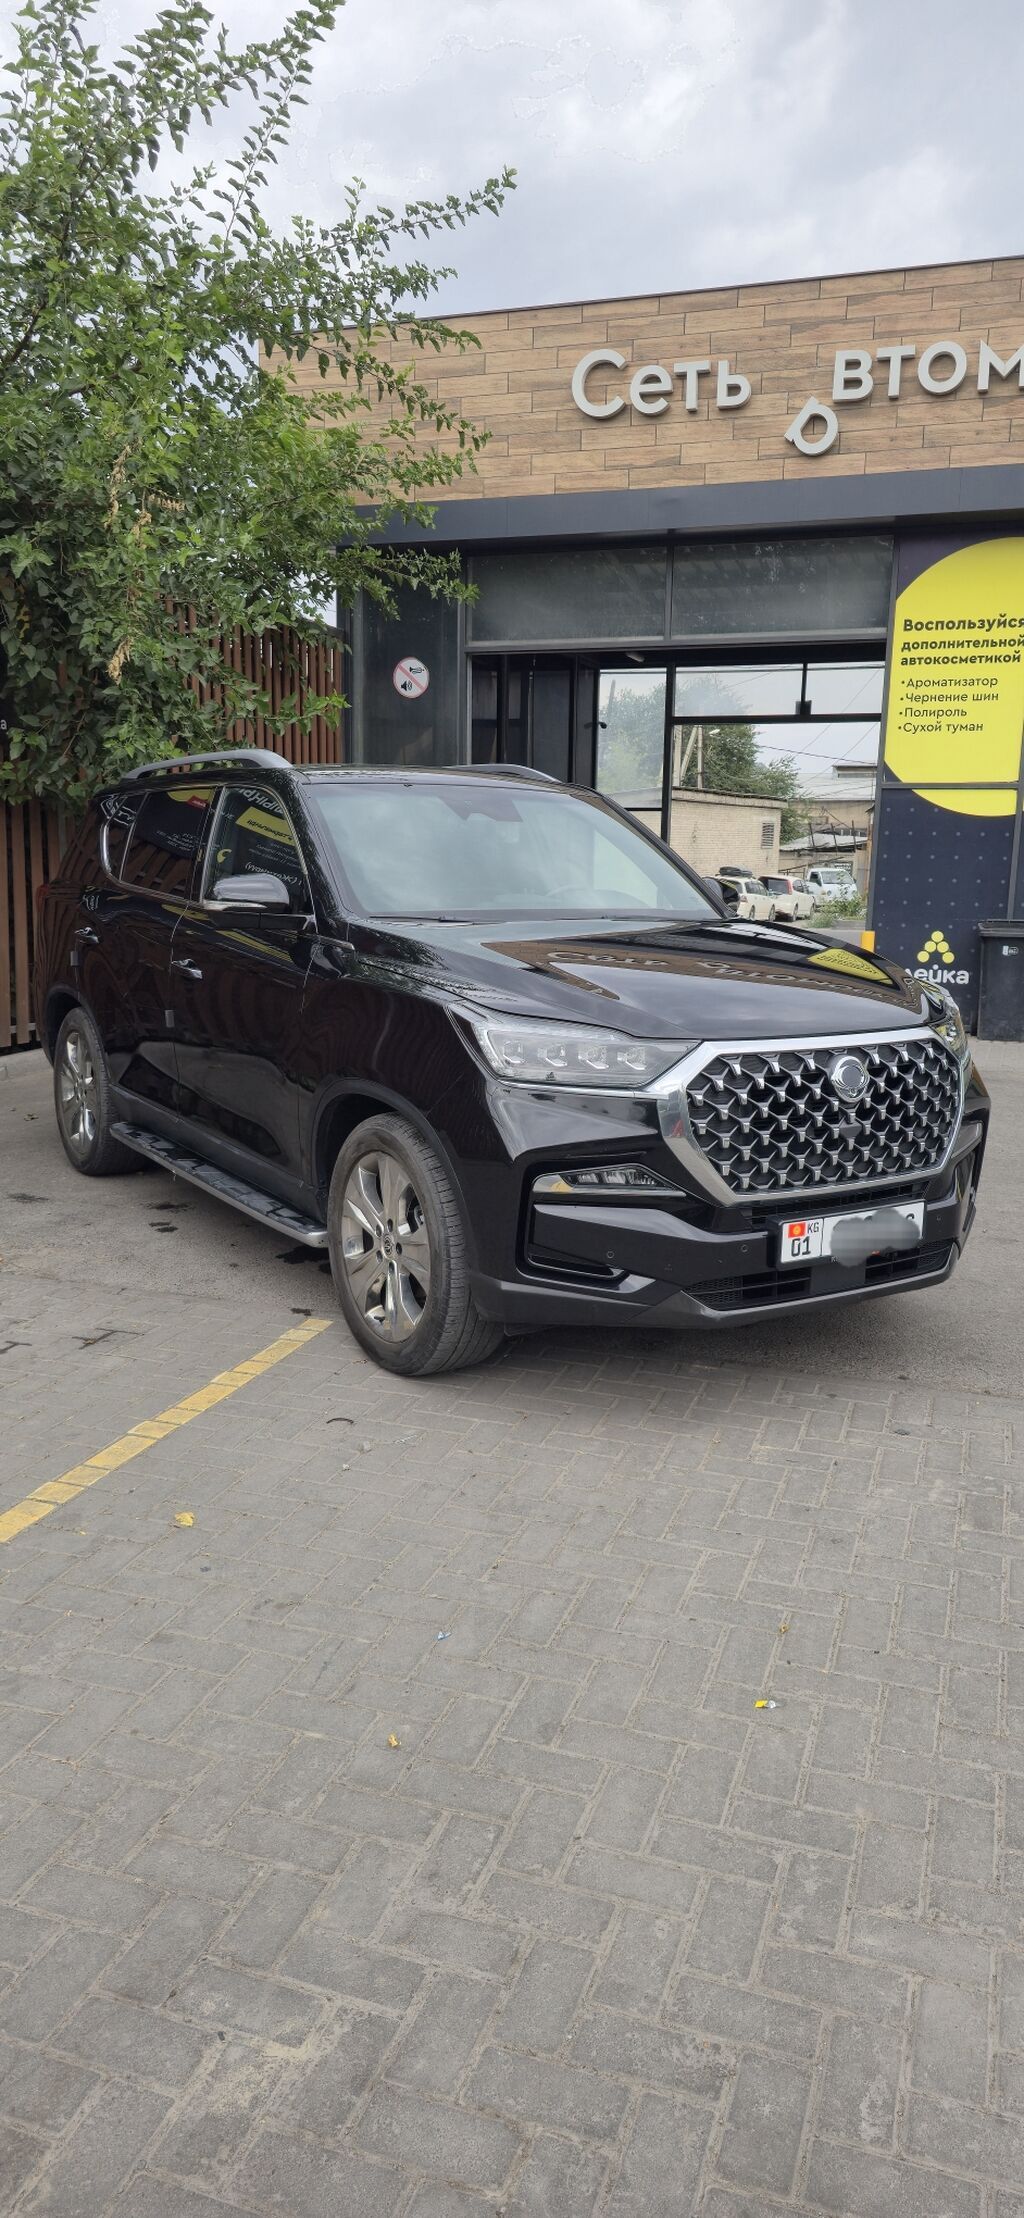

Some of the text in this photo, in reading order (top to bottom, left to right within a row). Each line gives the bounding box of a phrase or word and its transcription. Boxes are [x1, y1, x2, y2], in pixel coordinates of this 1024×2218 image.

[571, 348, 752, 420] Сеть
[903, 613, 1024, 632] Воспользуйся
[901, 634, 1024, 652] дополнительной
[901, 650, 1021, 665] автокосметикой
[906, 677, 998, 689] Ароматизатор
[905, 692, 999, 704] Чернение шин
[904, 707, 967, 719] Полироль
[903, 720, 984, 734] Сухой туман
[807, 1221, 820, 1233] KG
[791, 1236, 812, 1257] 01
